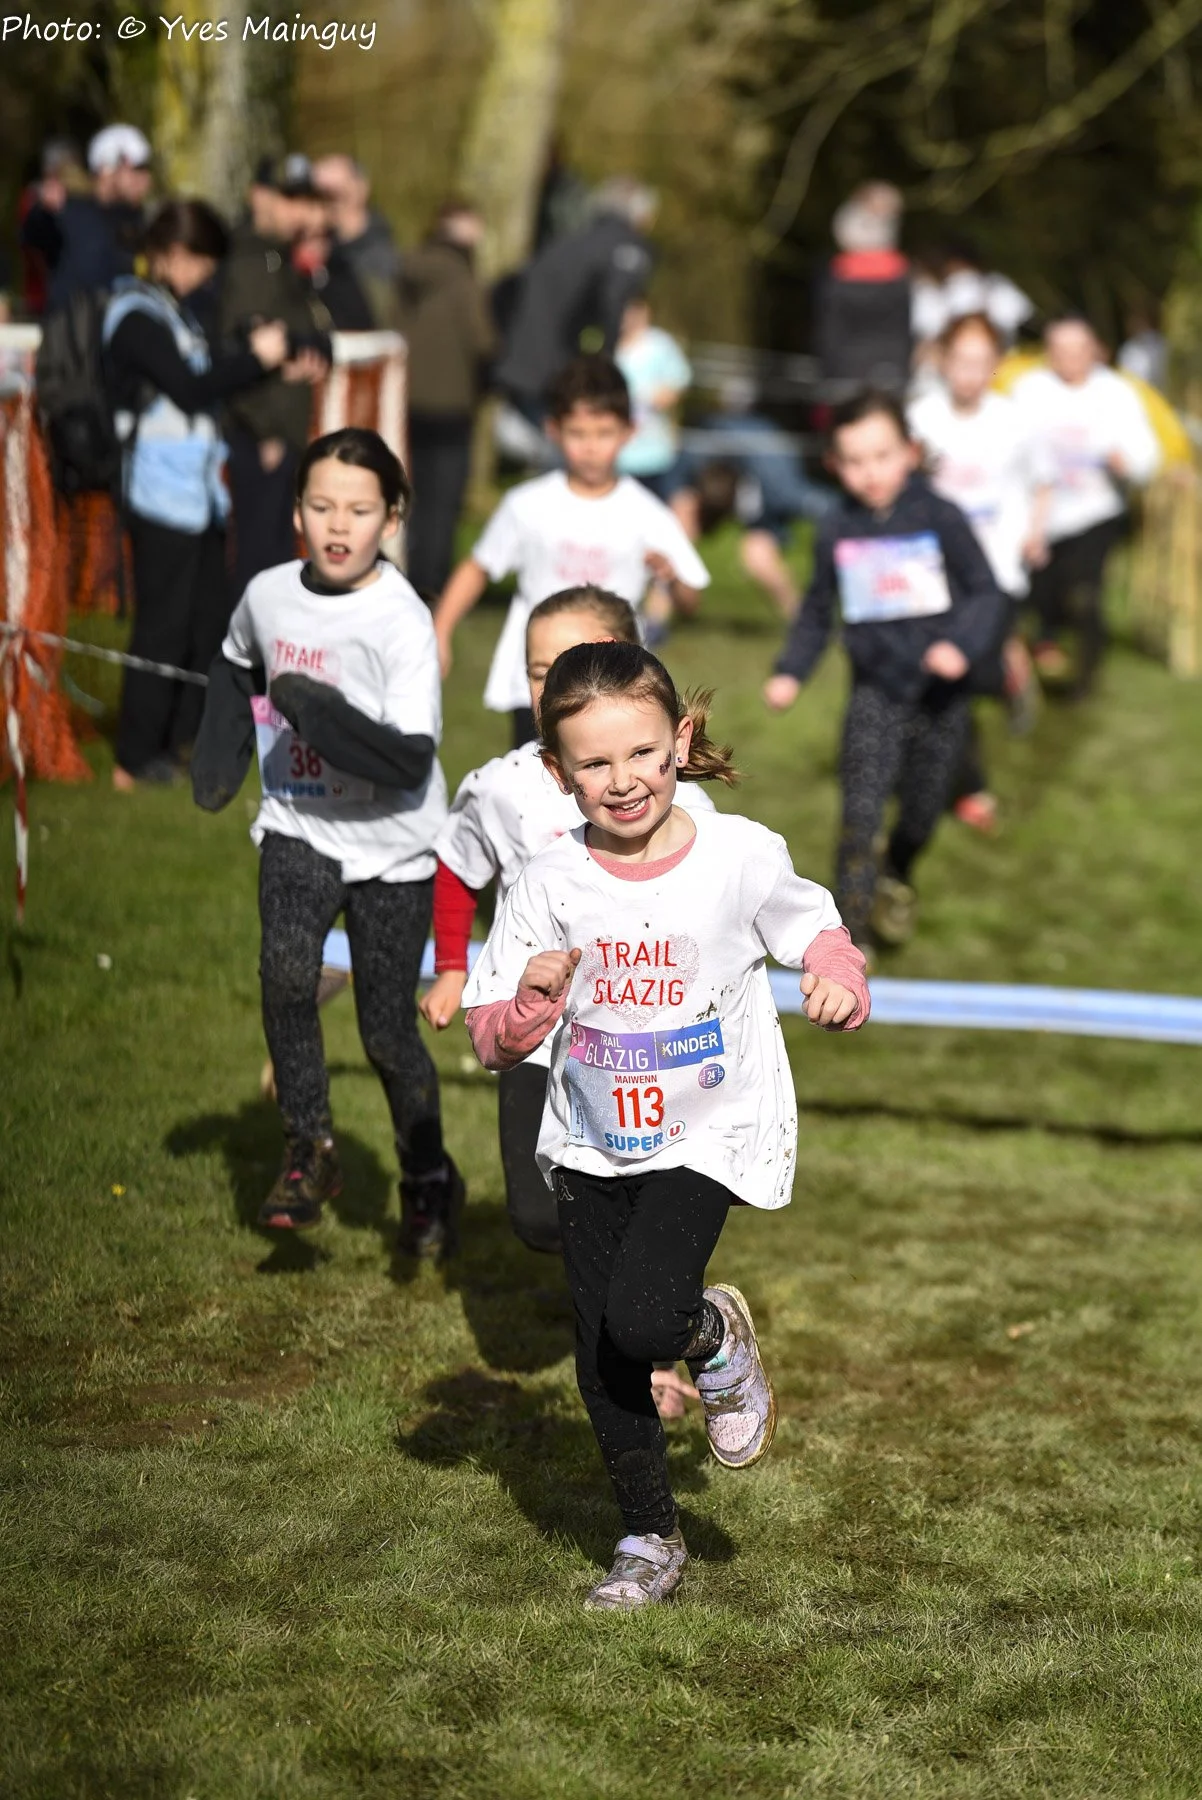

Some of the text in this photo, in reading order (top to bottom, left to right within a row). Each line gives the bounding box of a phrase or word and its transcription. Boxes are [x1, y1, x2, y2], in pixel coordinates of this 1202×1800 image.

[275, 639, 324, 669] TRAIL
[596, 940, 677, 968] TRAIL
[592, 978, 684, 1006] GLAZIG
[600, 1033, 622, 1048] TRAIL
[661, 1032, 719, 1058] KINDER
[584, 1042, 649, 1070] GLAZIG
[614, 1074, 658, 1084] MAIWENN
[611, 1087, 665, 1129] 113
[604, 1132, 664, 1152] SUPER
